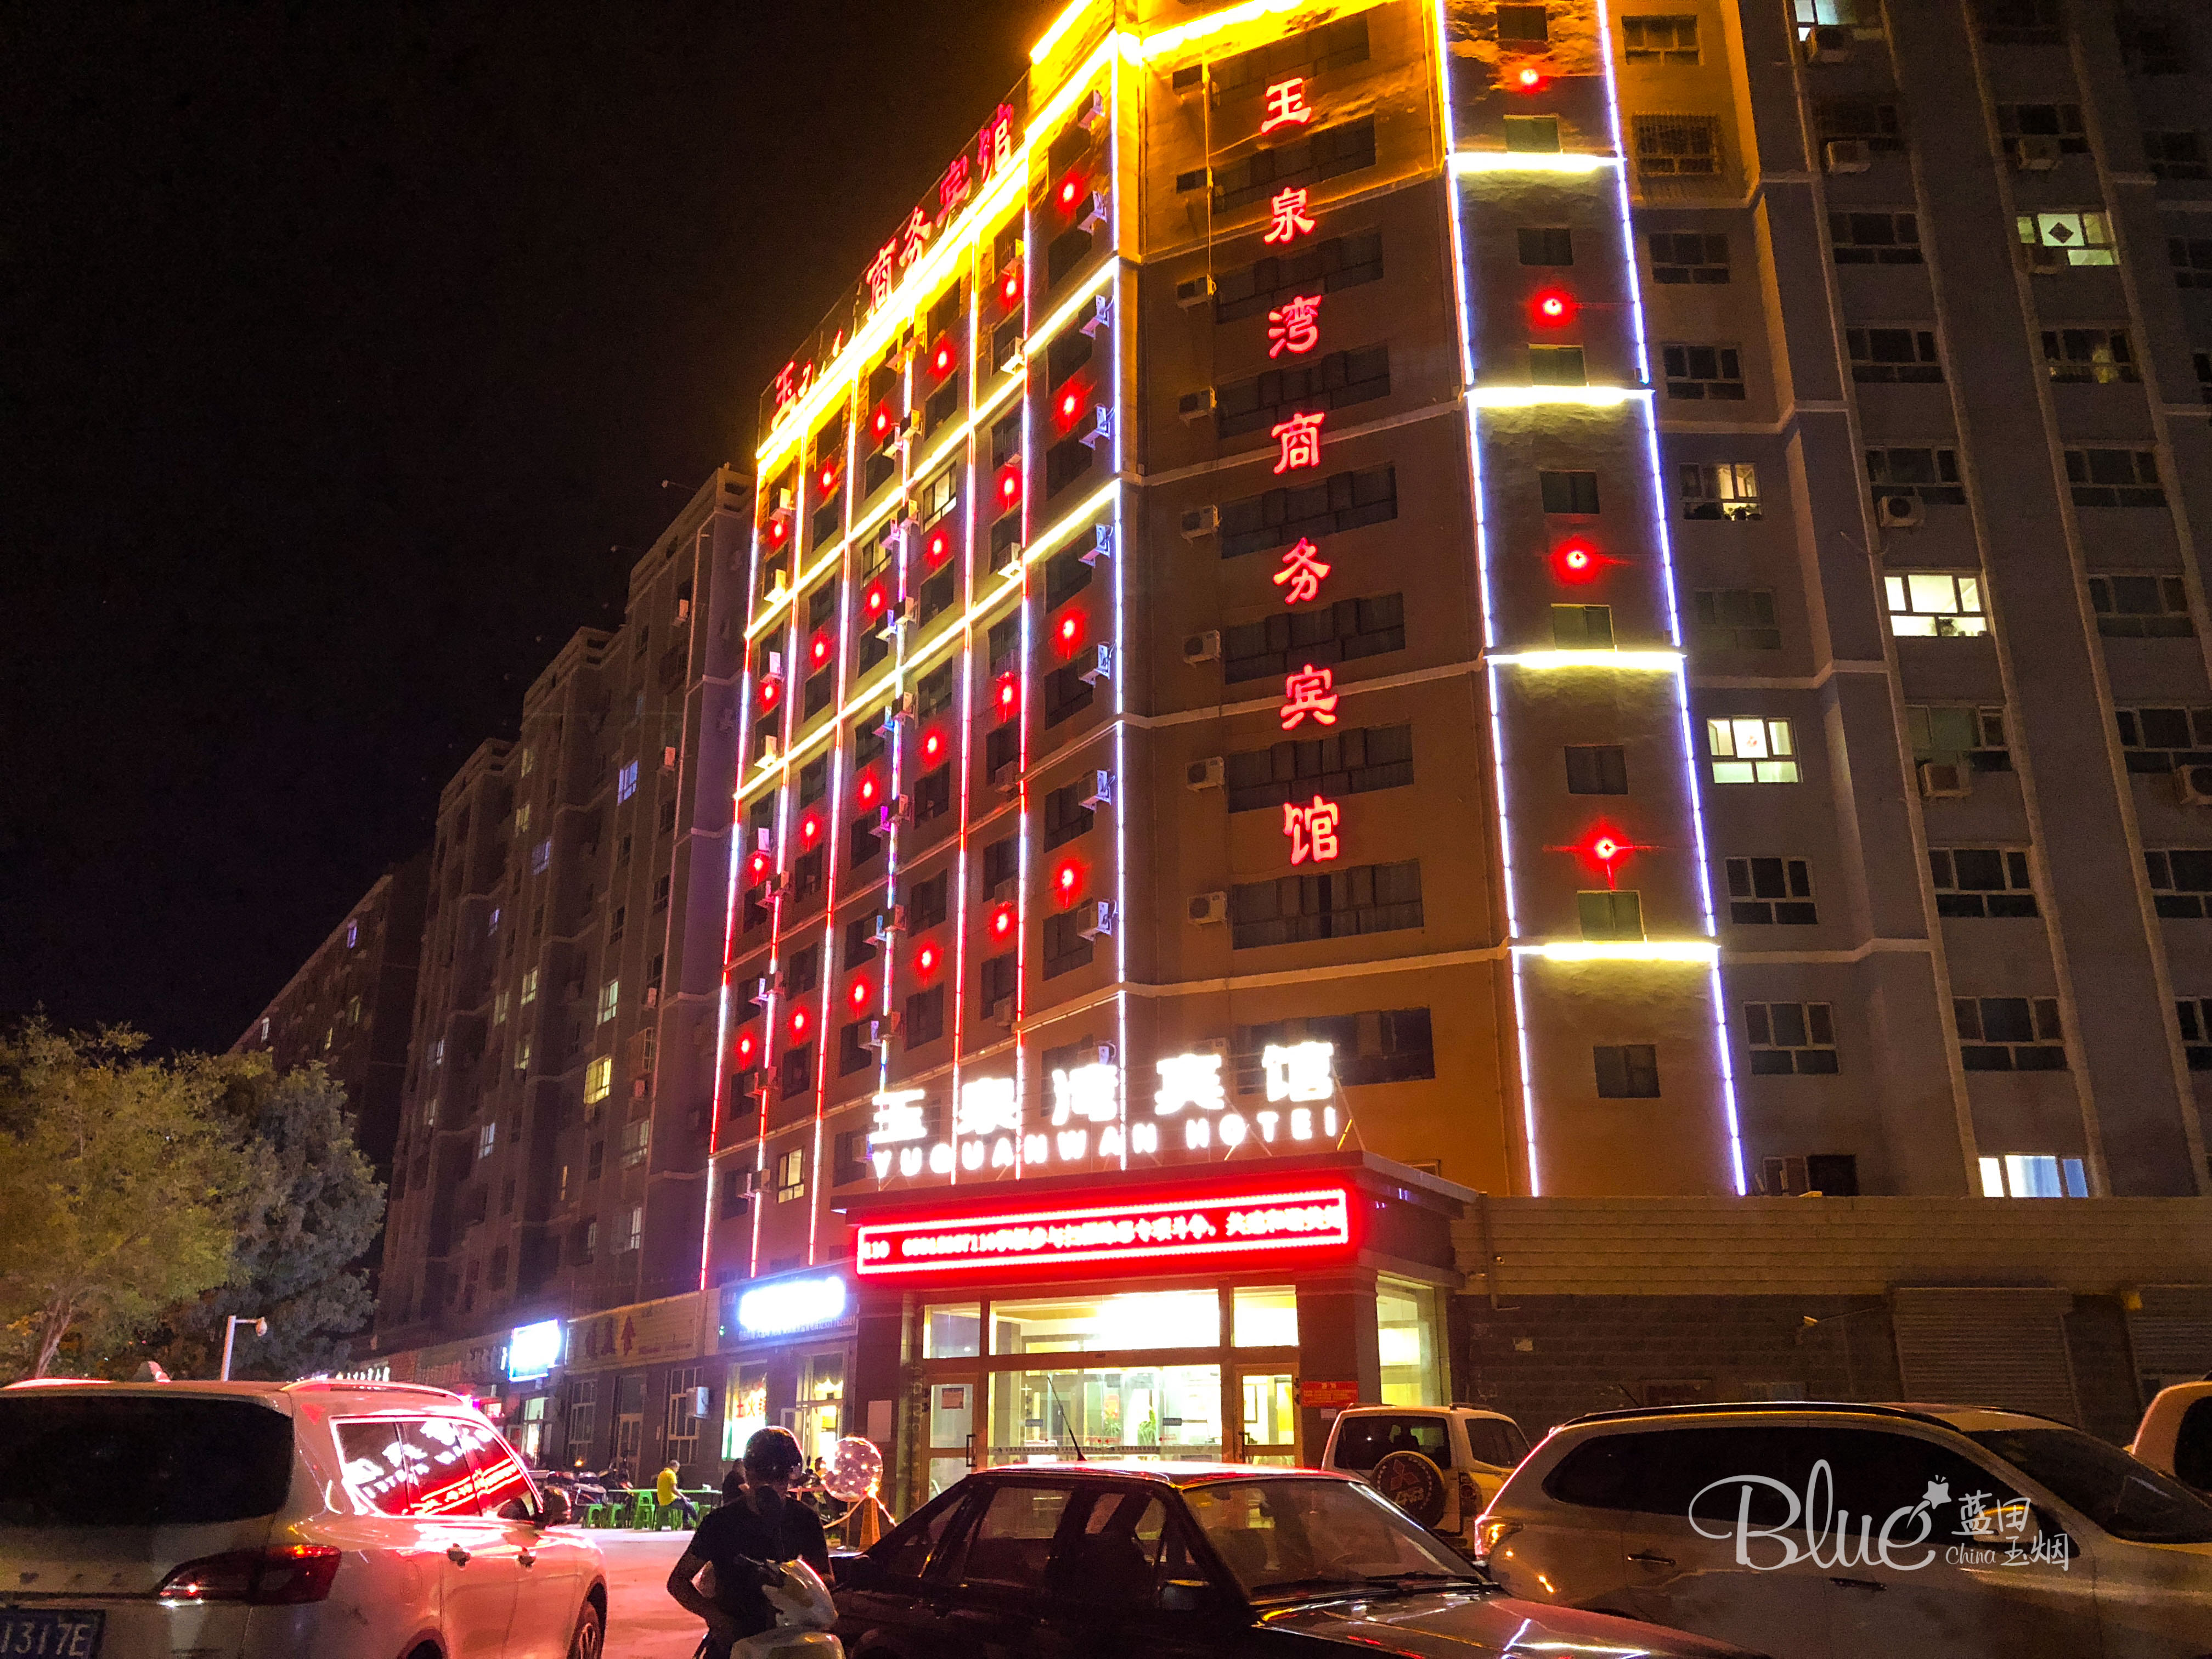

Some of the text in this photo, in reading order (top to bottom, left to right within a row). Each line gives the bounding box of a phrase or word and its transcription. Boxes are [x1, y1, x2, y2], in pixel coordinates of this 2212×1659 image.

[1261, 77, 1339, 866] 玉泉湾商务宾馆
